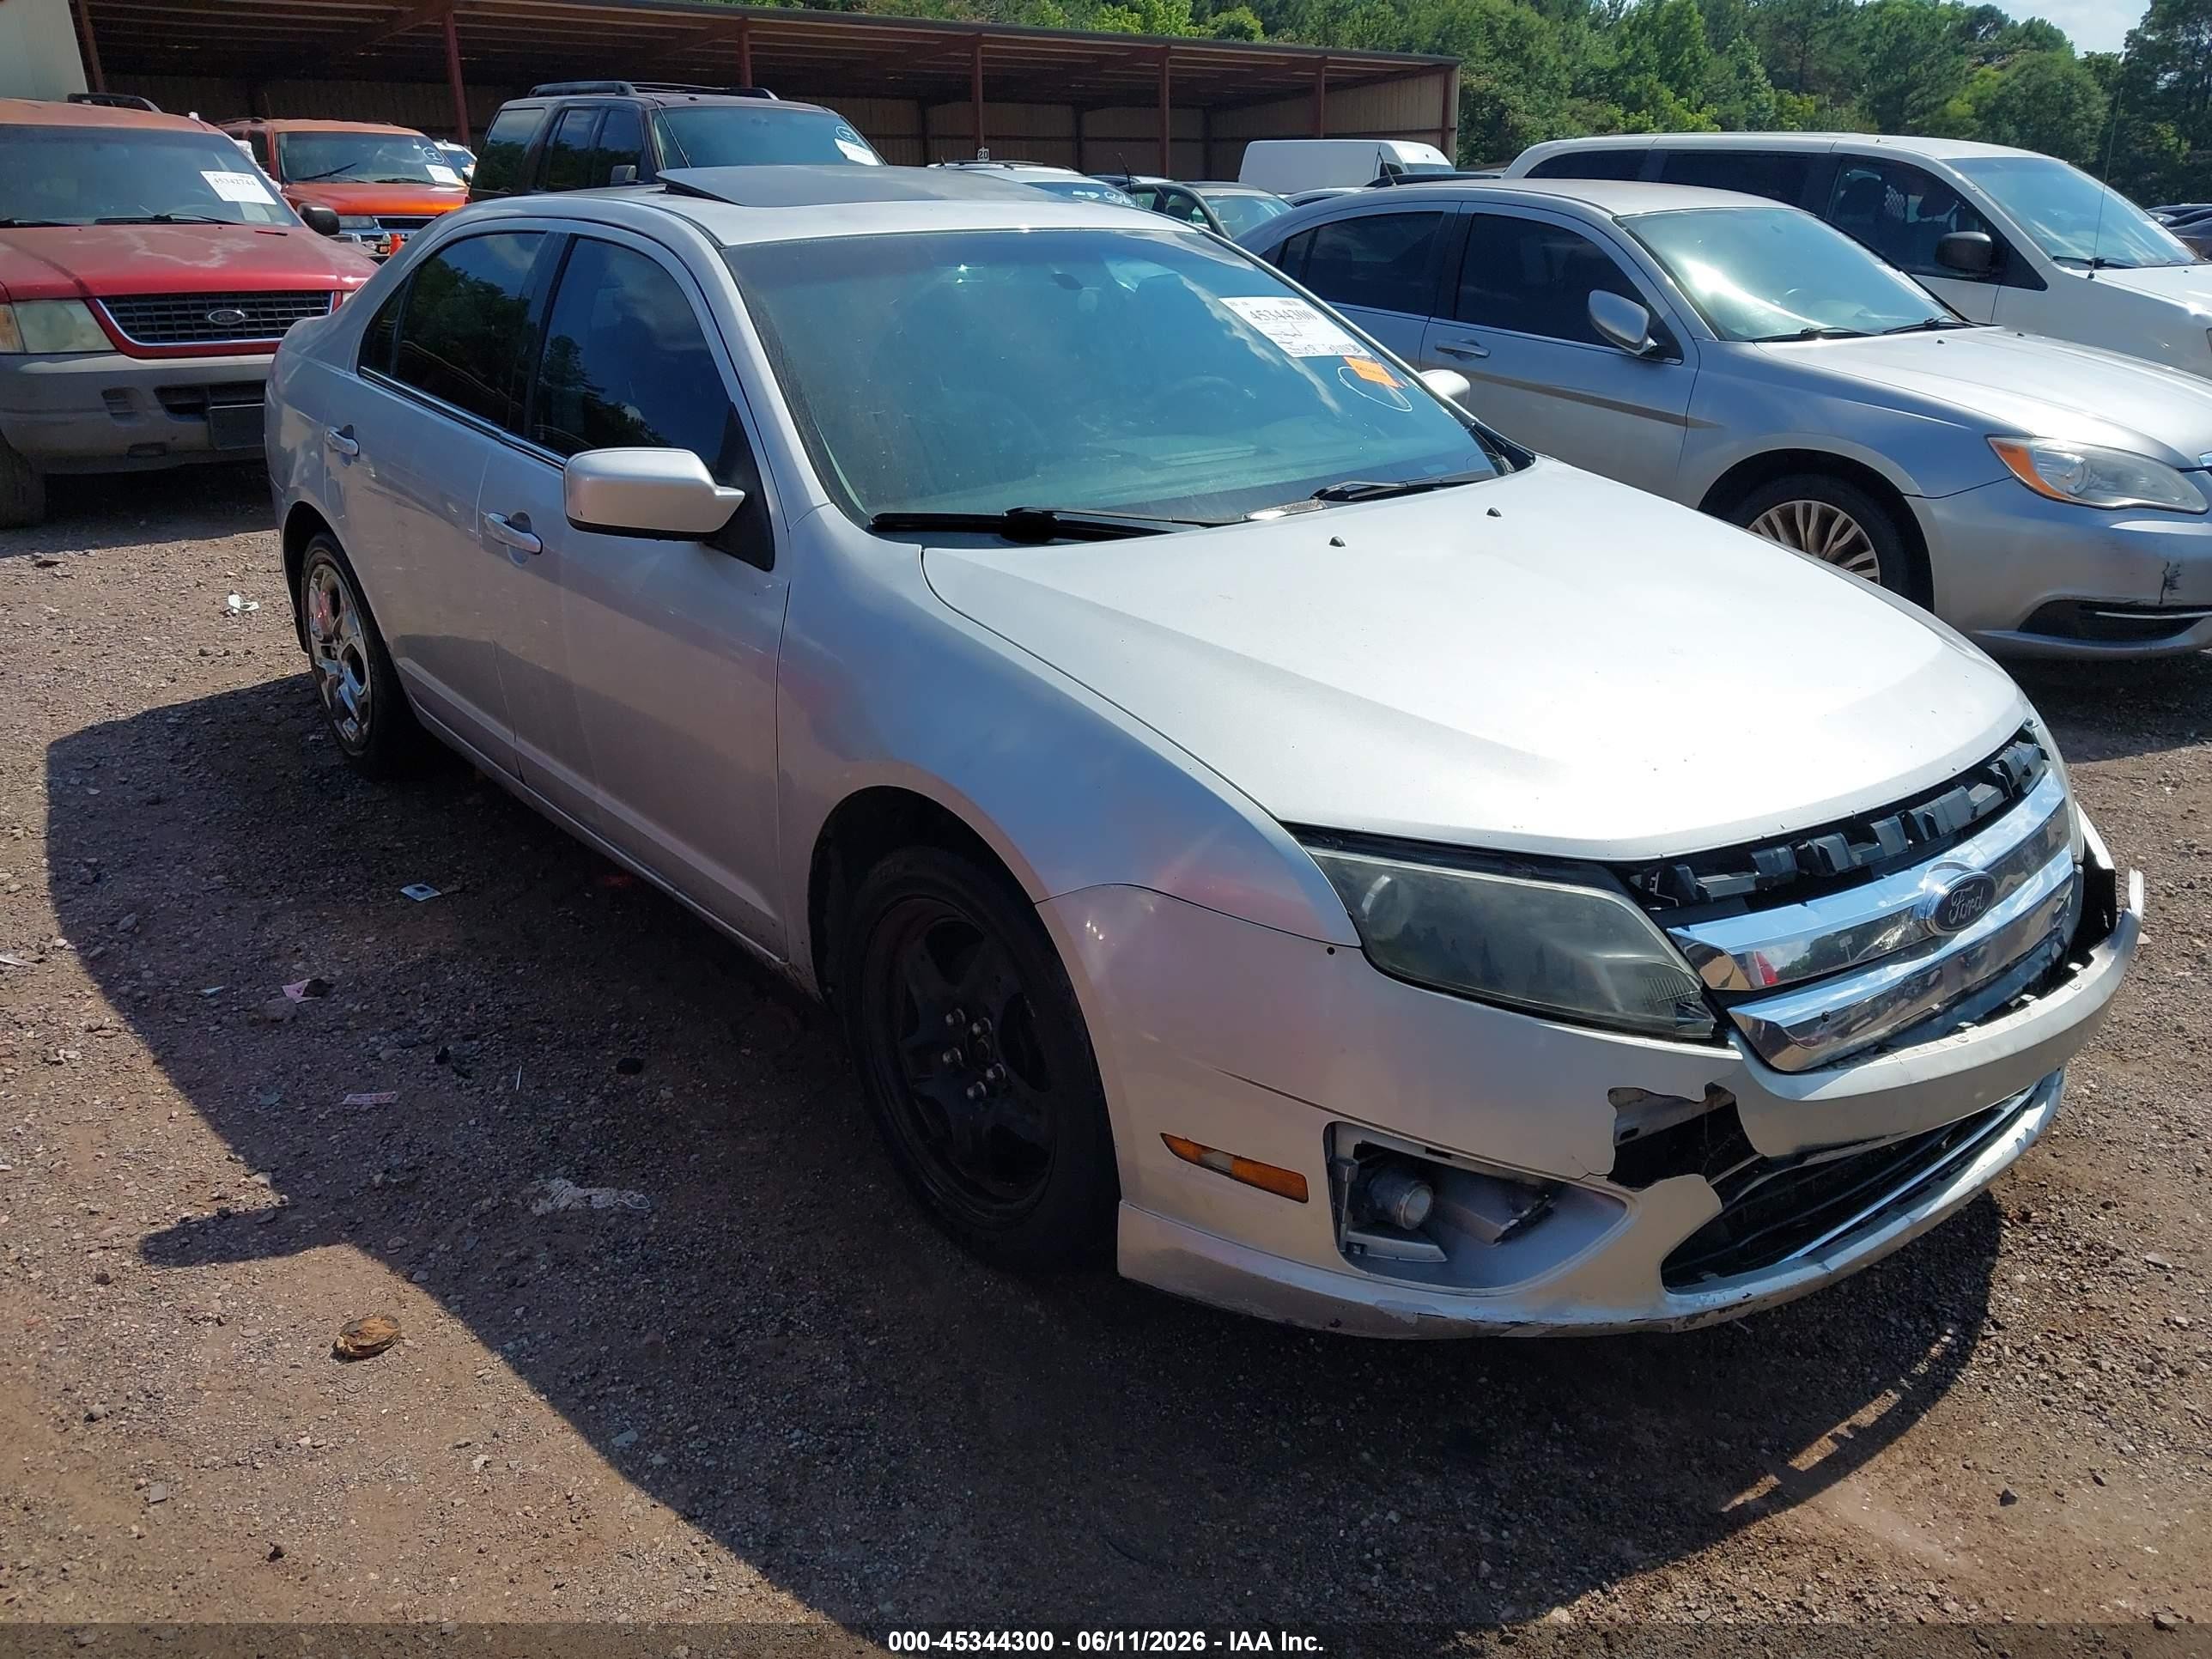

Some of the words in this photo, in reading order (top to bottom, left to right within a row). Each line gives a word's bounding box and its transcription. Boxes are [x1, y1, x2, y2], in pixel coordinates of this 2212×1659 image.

[978, 150, 988, 160] 20
[1249, 309, 1318, 321] 45344300
[1948, 884, 1985, 924] Ford
